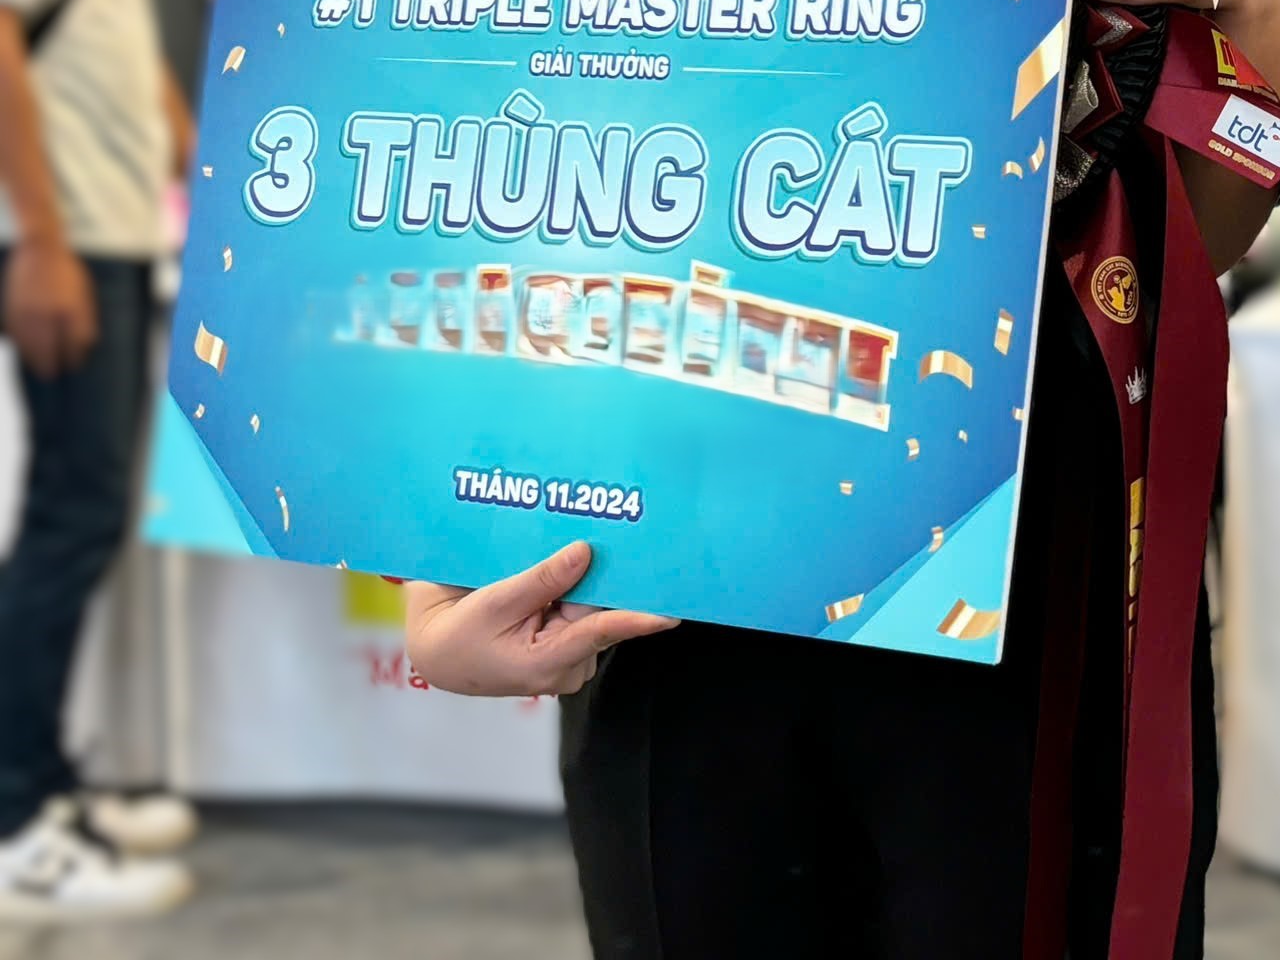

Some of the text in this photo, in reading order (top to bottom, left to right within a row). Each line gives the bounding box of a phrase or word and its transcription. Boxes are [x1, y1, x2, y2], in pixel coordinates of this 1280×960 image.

[529, 45, 670, 80] GIẢI THƯỞNG
[247, 93, 968, 263] 3 THÙNG CÁT
[1208, 138, 1276, 180] GOLD SPONSOR
[455, 467, 642, 518] THÁNG 11.2024
